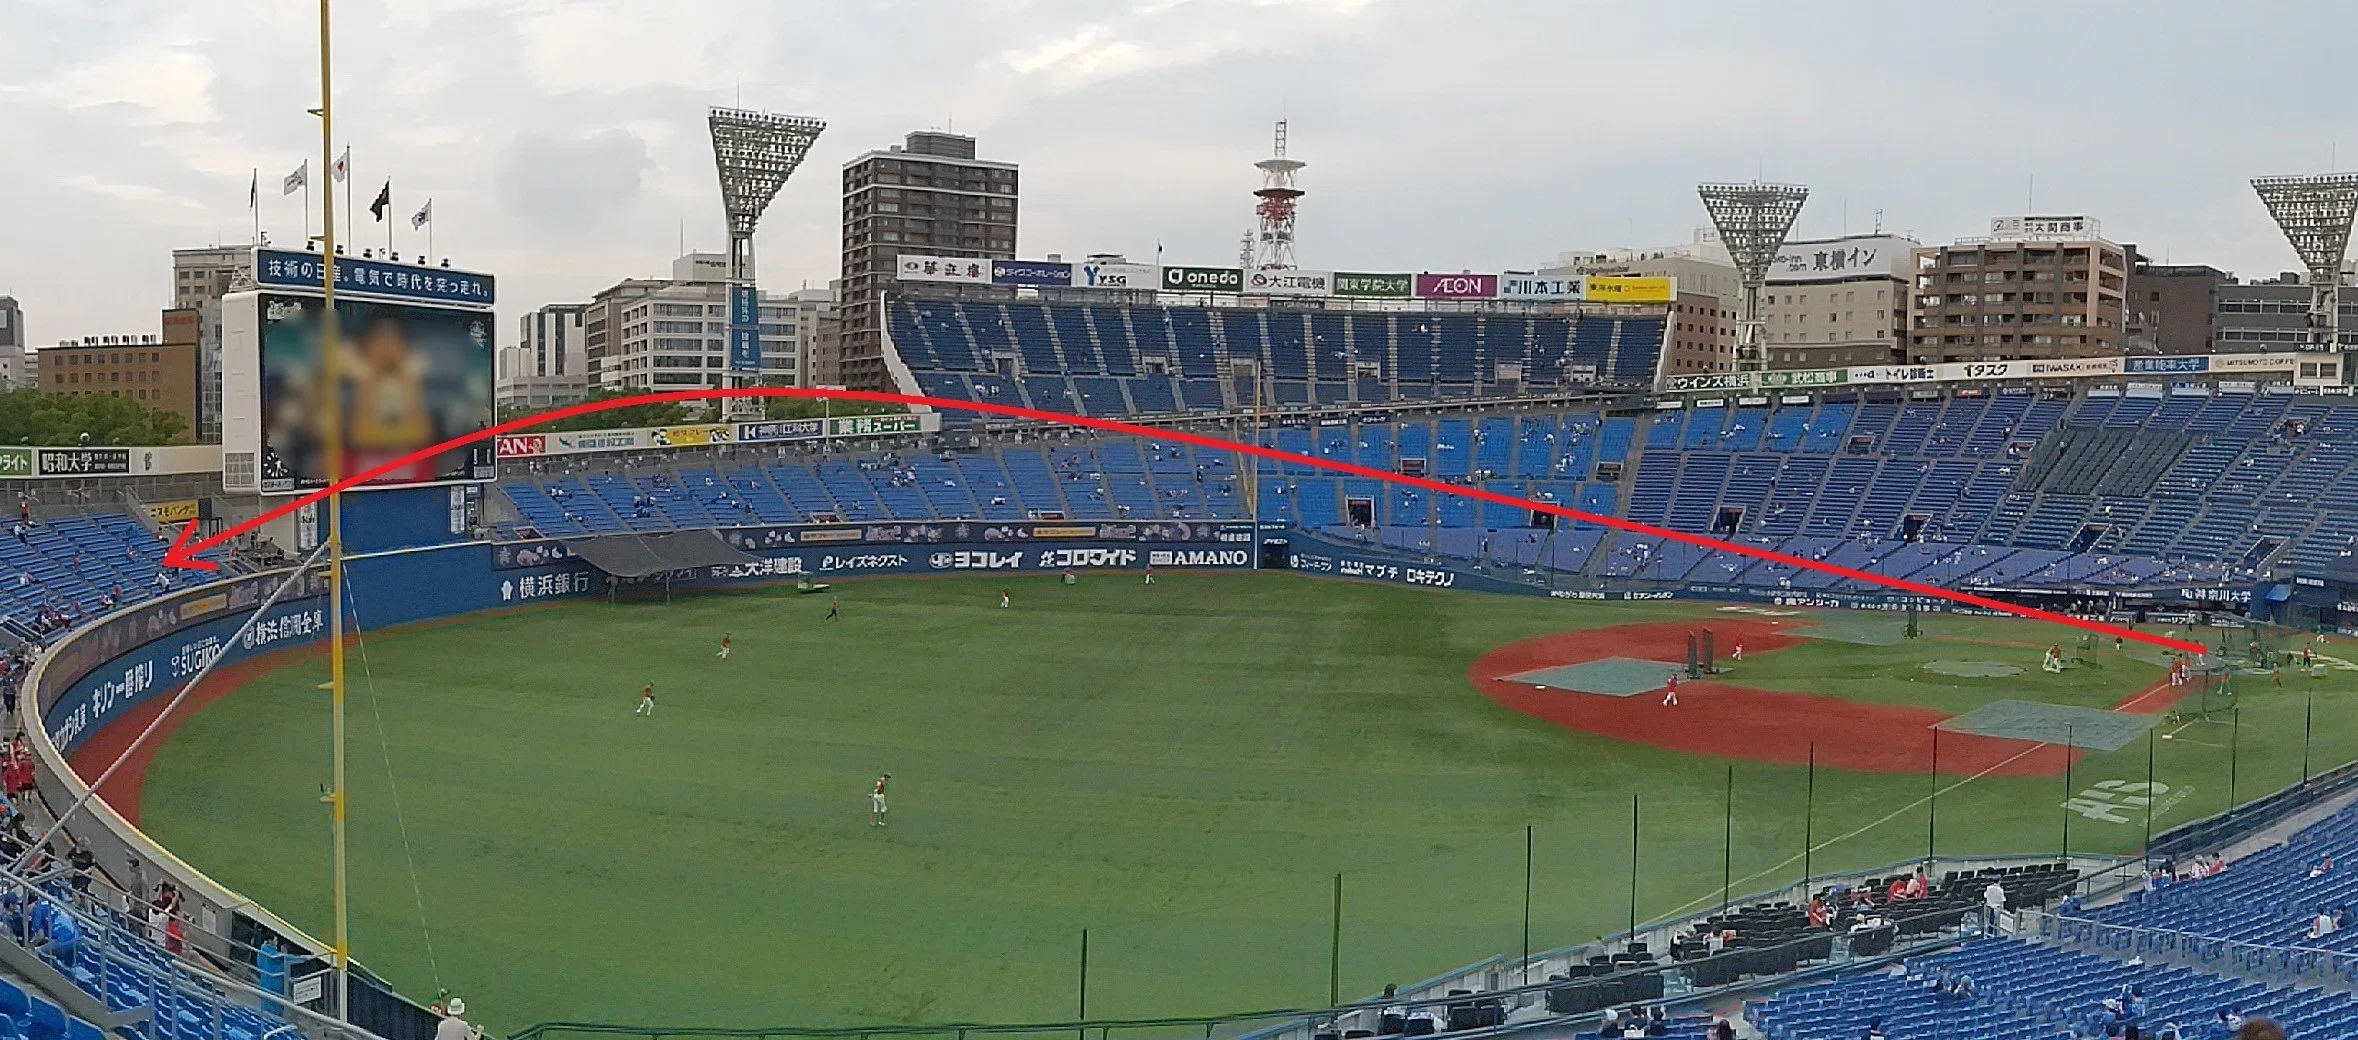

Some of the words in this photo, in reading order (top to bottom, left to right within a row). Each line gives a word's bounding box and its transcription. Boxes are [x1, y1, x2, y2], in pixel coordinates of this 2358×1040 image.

[1813, 247, 1877, 271] 東横イン
[1269, 275, 1325, 290] 大江電機
[1336, 277, 1409, 292] 関東学院大学
[1432, 277, 1482, 293] AEON
[1518, 279, 1581, 295] 川本工業
[1677, 373, 1750, 389] ウインズ横浜
[838, 418, 915, 436] 業務スーパー
[0, 454, 28, 471] ライト
[42, 451, 92, 472] 昭和大学
[745, 556, 802, 576] 大洋建設
[835, 554, 908, 569] レイズネクスト
[955, 550, 1023, 568] ヨコレイ
[1056, 549, 1137, 566] コロワイド
[1173, 551, 1248, 565] AMANO
[518, 570, 589, 600] 横浜銀行
[1406, 568, 1455, 587] ロキテクノ
[2195, 588, 2252, 603] 神奈川大学
[93, 660, 153, 718] キリン一番搾り
